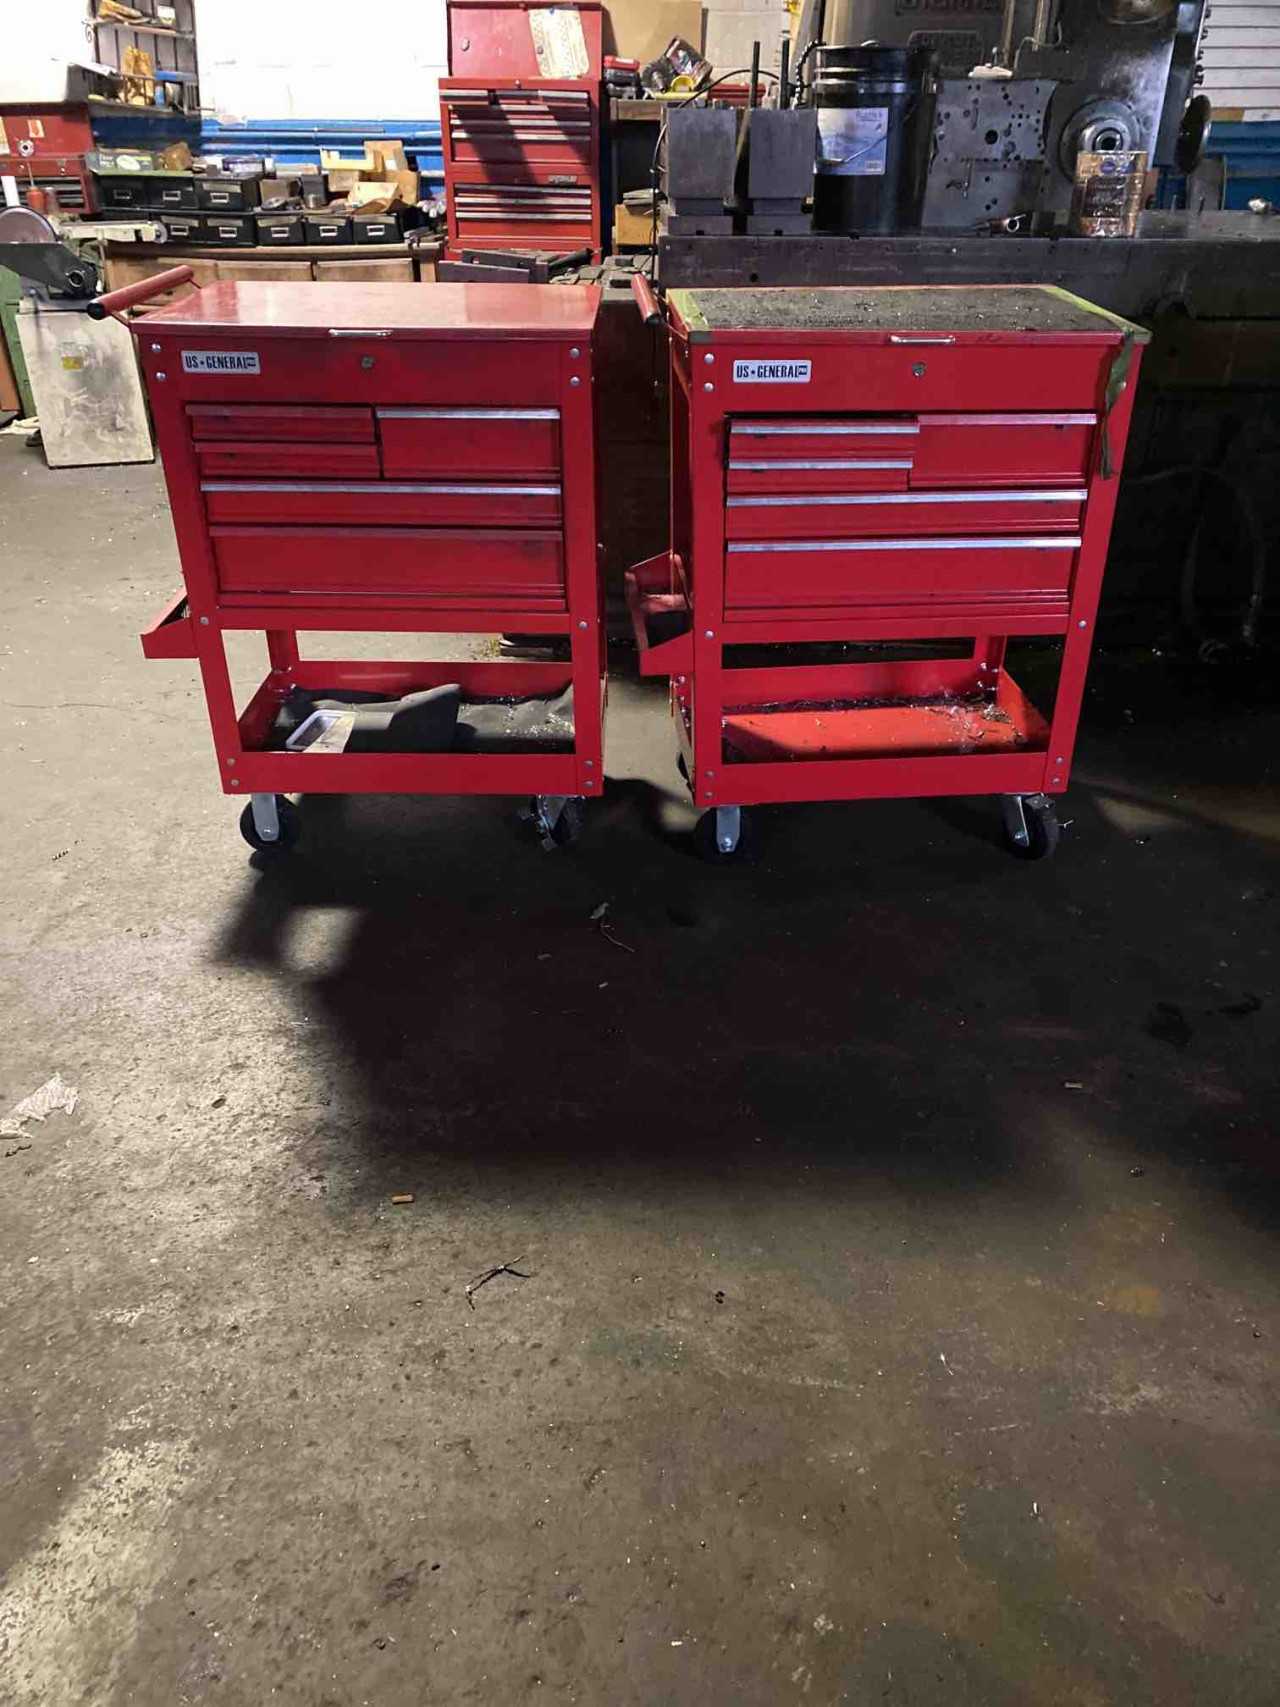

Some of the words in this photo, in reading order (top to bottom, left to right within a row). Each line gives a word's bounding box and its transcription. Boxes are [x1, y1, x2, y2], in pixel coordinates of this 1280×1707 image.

[185, 355, 199, 369] US
[206, 355, 248, 369] GENERAL
[736, 365, 749, 378] US
[757, 365, 799, 378] GENERAL
